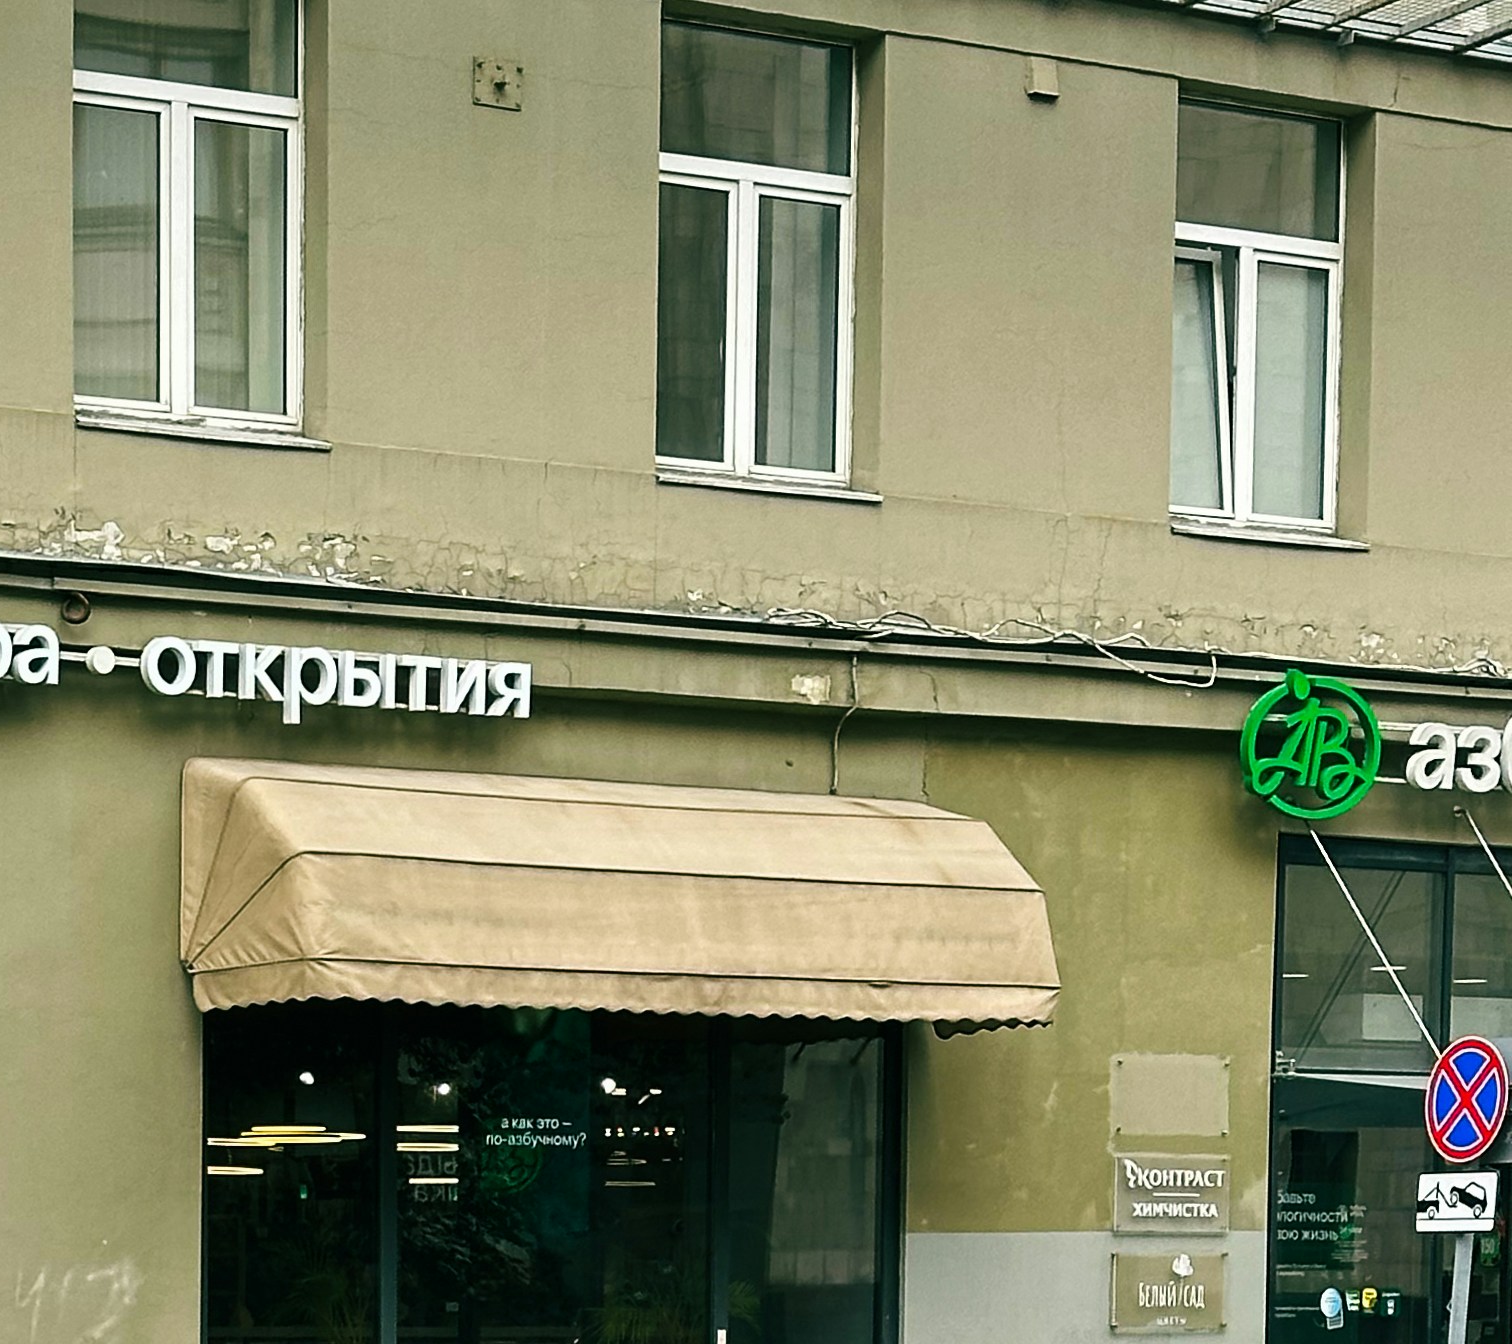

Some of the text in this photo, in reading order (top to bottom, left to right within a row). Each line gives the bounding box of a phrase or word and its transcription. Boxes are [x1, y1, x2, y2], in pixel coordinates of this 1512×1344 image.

[138, 635, 532, 724] открытия
[512, 1118, 534, 1129] как
[537, 1117, 559, 1129] это
[1137, 1166, 1227, 1189] КОНТРАСТ
[1132, 1202, 1219, 1218] ХИМЧИСТКА
[1138, 1280, 1205, 1309] БЕЛЫЙ САД
